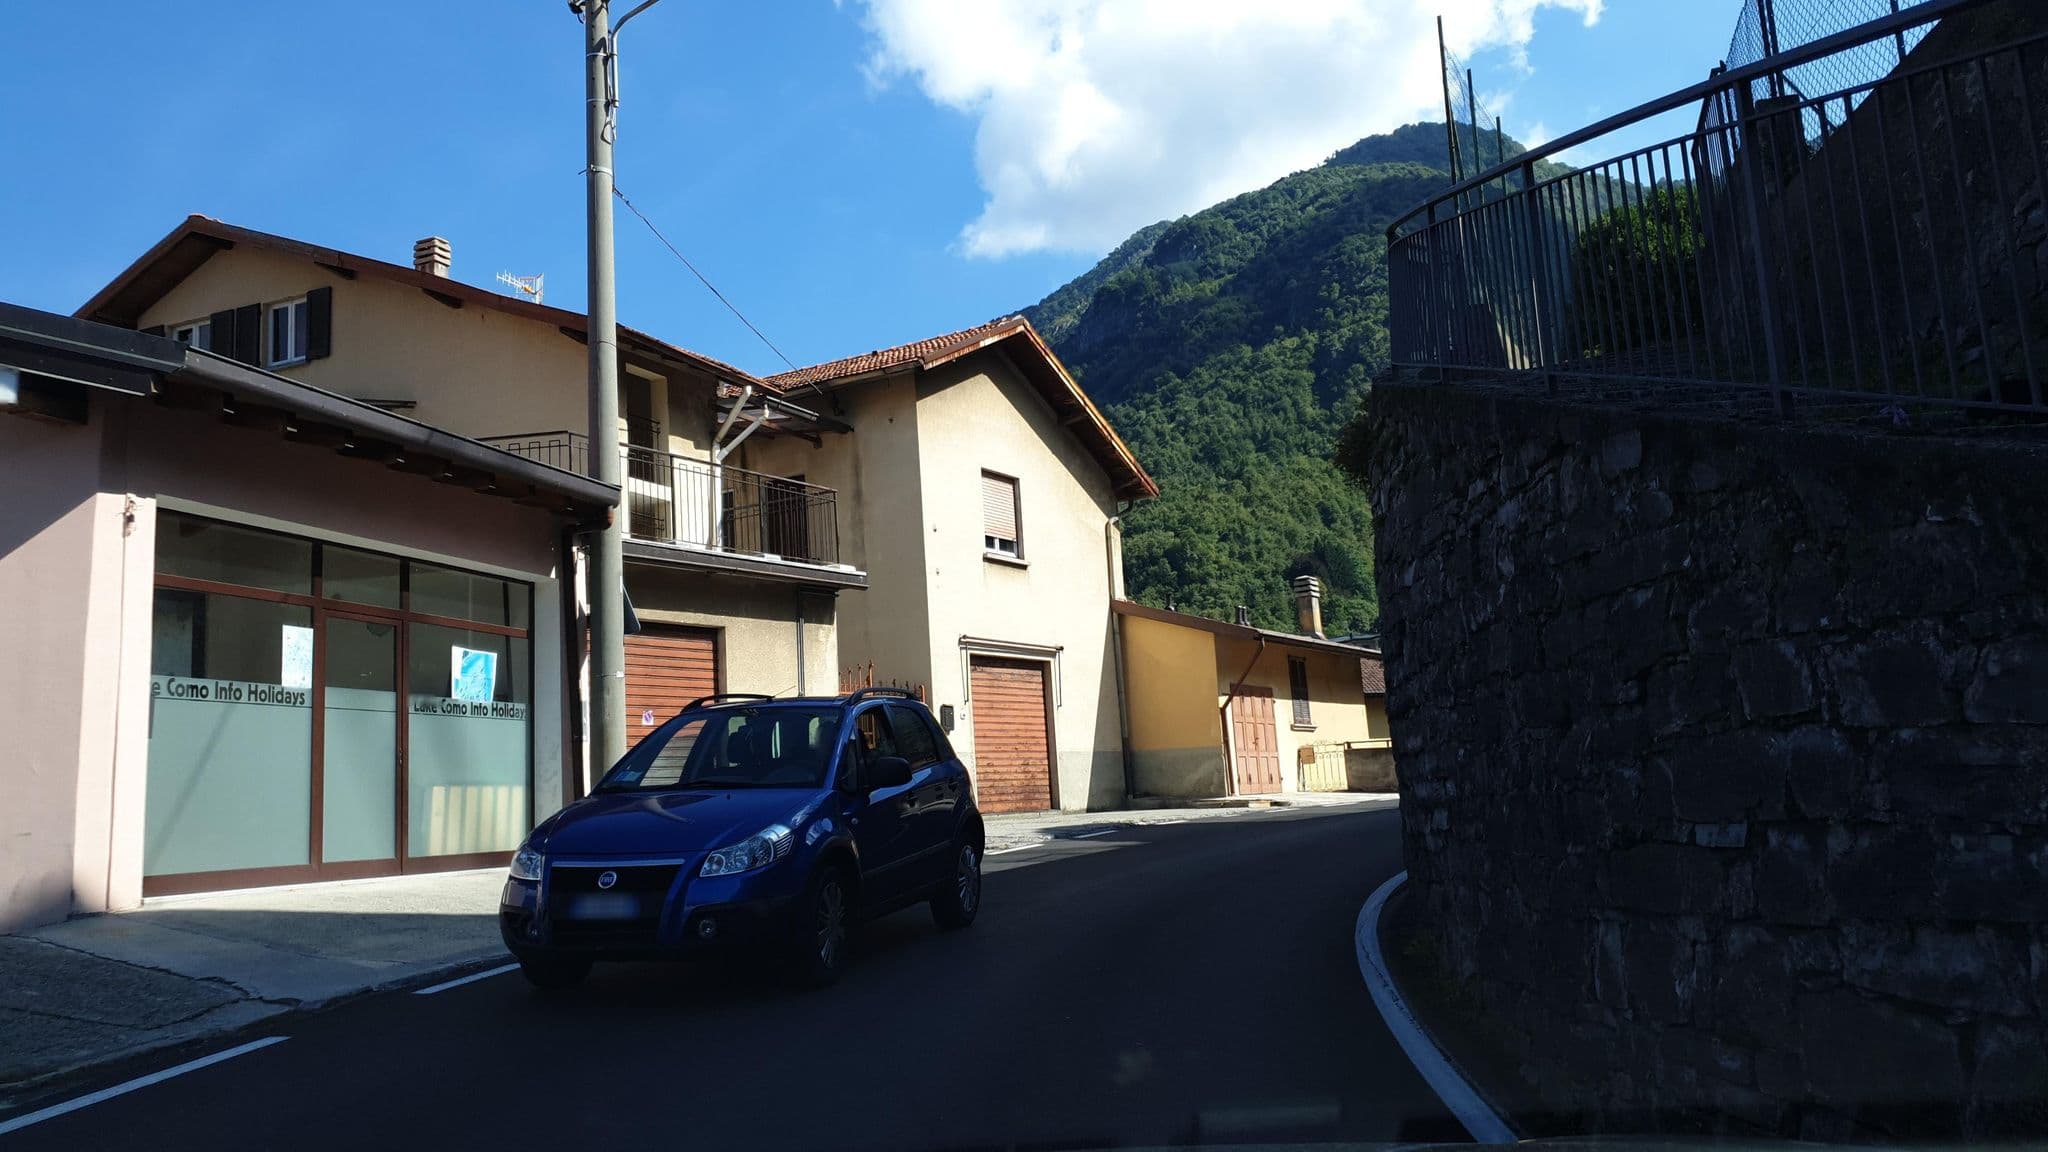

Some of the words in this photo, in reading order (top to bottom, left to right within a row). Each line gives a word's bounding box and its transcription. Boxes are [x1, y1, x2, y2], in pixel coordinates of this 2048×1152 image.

[167, 677, 209, 699] Como
[214, 680, 243, 702] Info
[247, 684, 306, 706] Holidays
[441, 699, 467, 715] Como
[470, 701, 489, 716] Info
